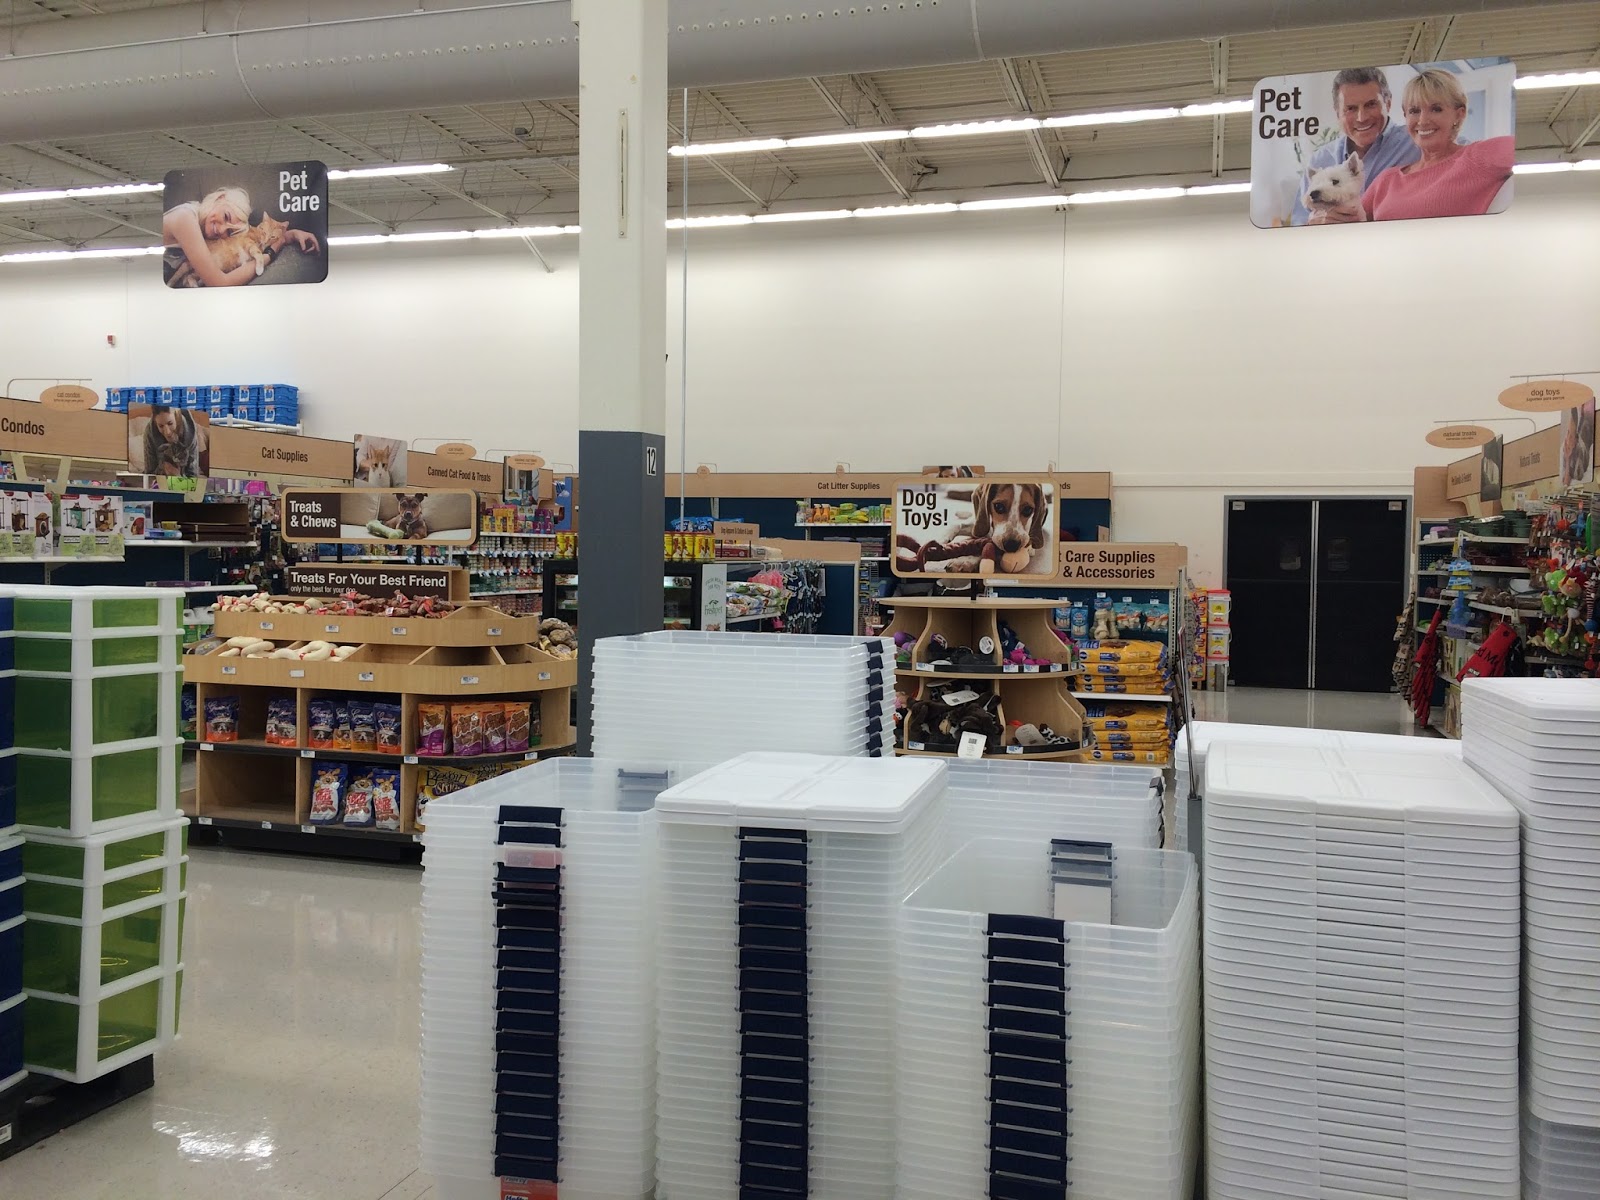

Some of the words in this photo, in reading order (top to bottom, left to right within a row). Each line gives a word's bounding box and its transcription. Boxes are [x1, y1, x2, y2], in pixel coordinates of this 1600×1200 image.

[1260, 86, 1302, 113] Pet
[1258, 114, 1320, 139] Care
[279, 170, 308, 192] Pet
[279, 192, 320, 213] Care
[1530, 389, 1544, 397] dog
[1545, 388, 1561, 396] toys
[1, 417, 45, 436] Condos
[261, 446, 275, 459] Cat
[276, 448, 309, 463] Supplies
[647, 447, 656, 475] 12
[427, 466, 448, 478] Canned
[448, 468, 459, 479] Cat
[458, 469, 472, 480] Food
[472, 472, 476, 481] &
[476, 471, 492, 483] Treats
[817, 482, 829, 490] Cat
[830, 482, 849, 490] Litter
[850, 482, 881, 491] Supplies
[289, 500, 322, 513] Treats
[902, 489, 937, 510] Dog
[290, 515, 299, 528] &
[301, 514, 337, 528] Chews
[901, 508, 948, 530] Toys!
[1065, 550, 1095, 563] Care
[1098, 550, 1156, 566] Supplies
[290, 571, 326, 584] Treats
[328, 572, 348, 585] For
[349, 573, 377, 586] Your
[379, 574, 406, 587] Best
[409, 575, 447, 588] Friend
[1063, 565, 1073, 578] &
[1075, 565, 1156, 579] Accessories
